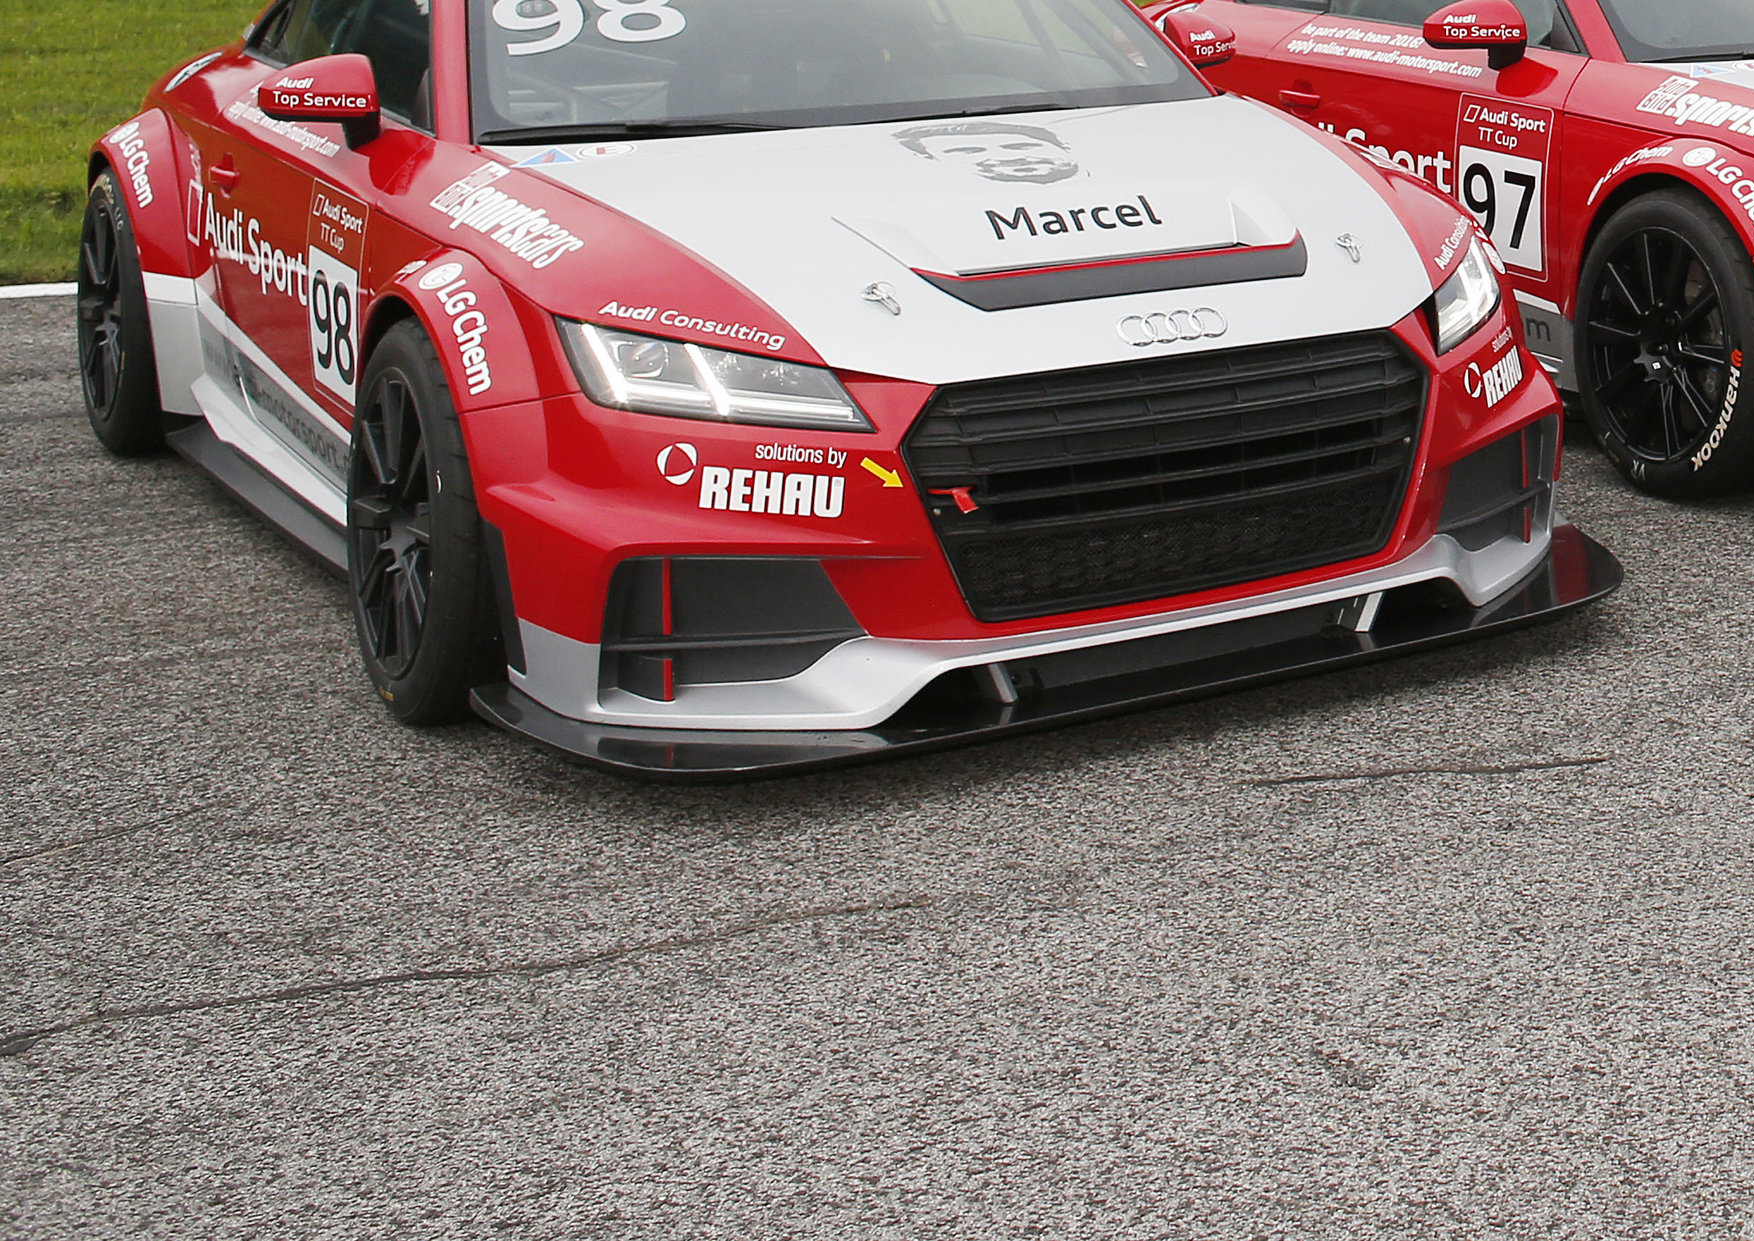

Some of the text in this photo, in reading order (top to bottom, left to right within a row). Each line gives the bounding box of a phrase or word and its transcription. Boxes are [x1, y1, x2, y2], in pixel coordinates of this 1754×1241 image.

[1442, 14, 1477, 24] Audi
[1443, 25, 1521, 40] Top Service
[1189, 29, 1216, 42] Audi
[1311, 26, 1335, 40] part
[1349, 30, 1365, 42] the
[1365, 32, 1388, 45] team
[1193, 45, 1214, 57] Top
[1287, 39, 1483, 78] apply online: www.audi-motorsport.com
[276, 76, 314, 89] Audi
[273, 91, 367, 108] Top Service
[1480, 107, 1547, 133] Audi Sport
[1478, 126, 1518, 149] TT Cup
[323, 198, 364, 233] Audi Sport
[986, 194, 1163, 241] Marcel
[1462, 162, 1536, 250] 97
[205, 192, 307, 306] Audi Sport
[320, 222, 345, 252] TT Cup
[1434, 246, 1454, 270] Audi
[312, 269, 355, 386] 98
[598, 301, 786, 351] Audi Consulting
[1482, 345, 1524, 408] REHAU
[755, 442, 848, 469] solutions by
[699, 465, 846, 518] REHAU
